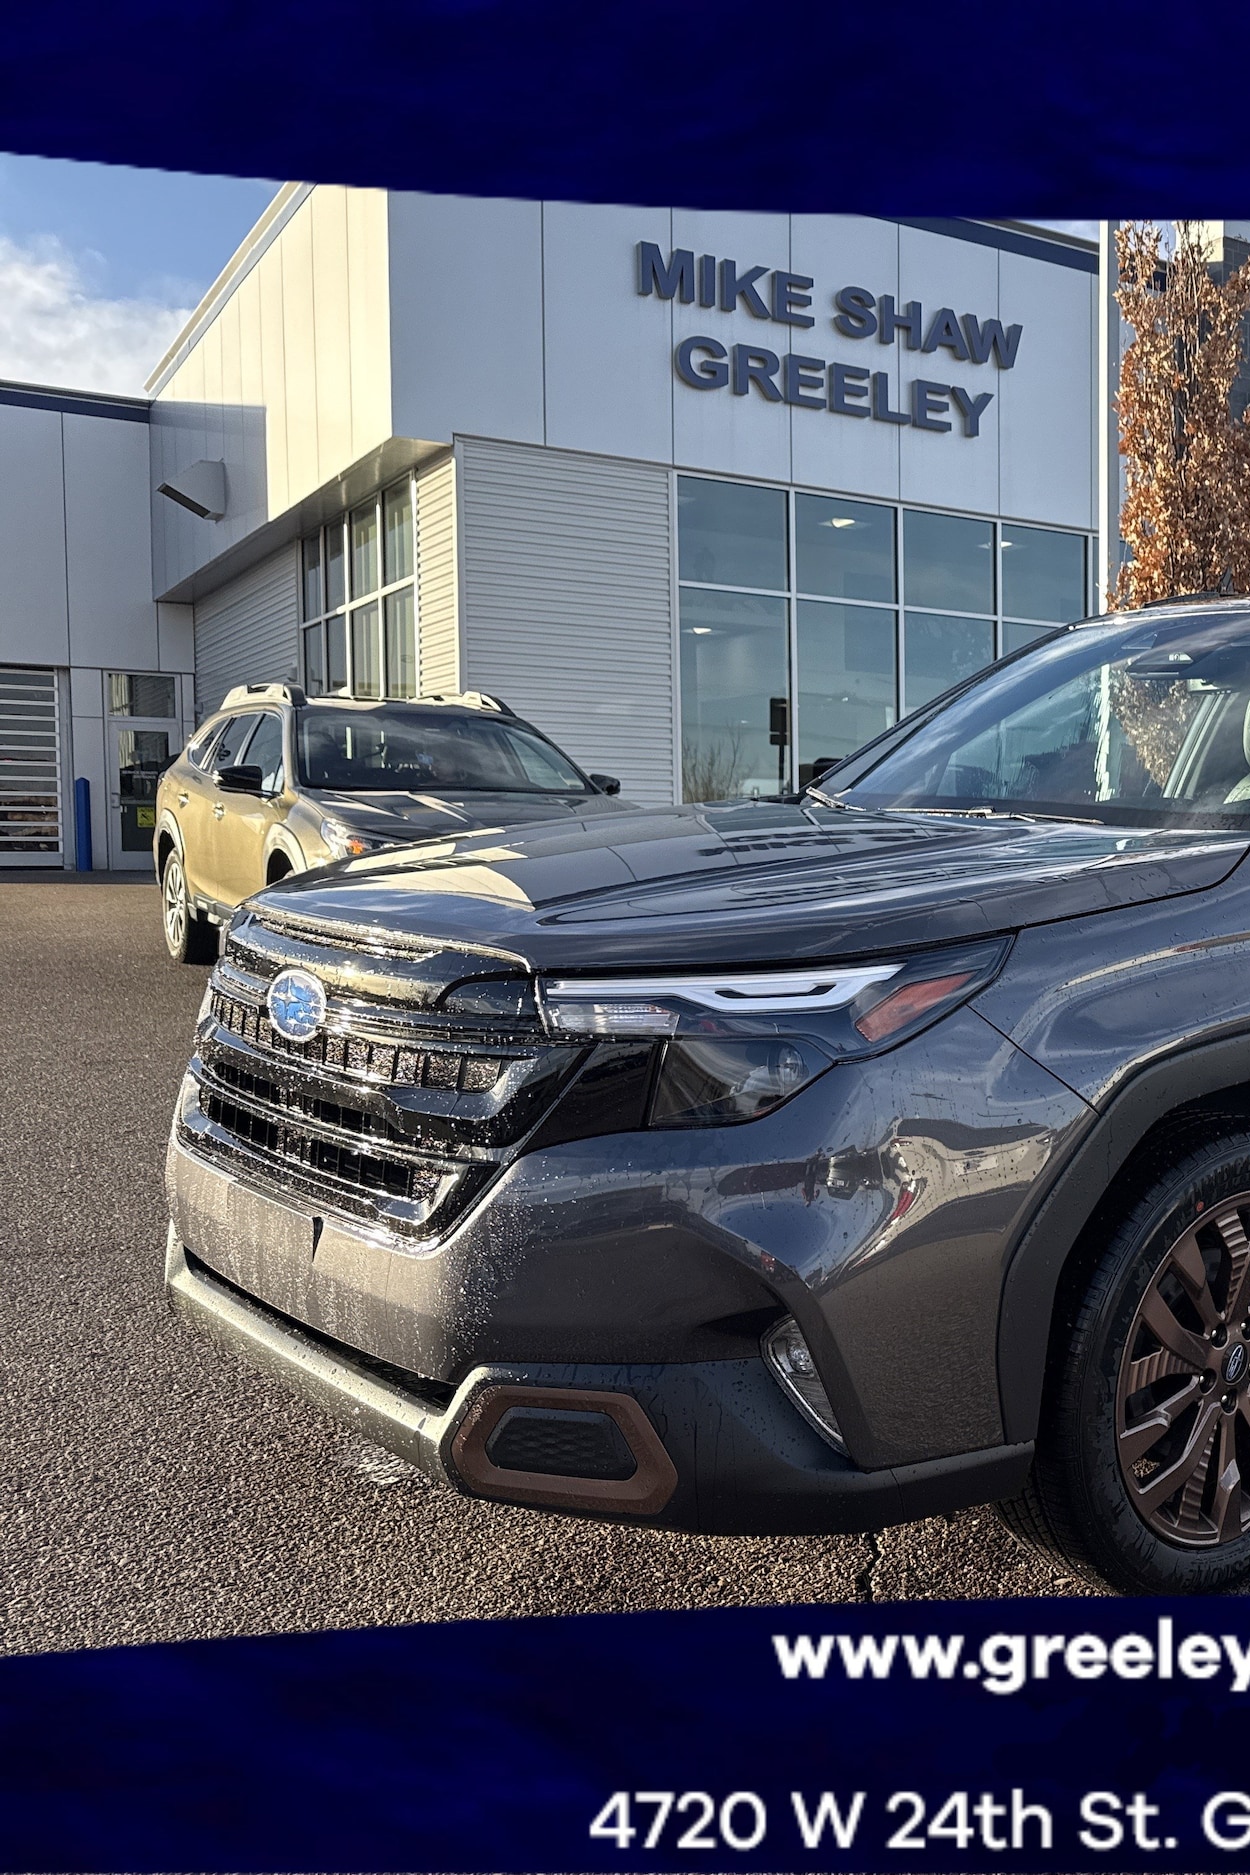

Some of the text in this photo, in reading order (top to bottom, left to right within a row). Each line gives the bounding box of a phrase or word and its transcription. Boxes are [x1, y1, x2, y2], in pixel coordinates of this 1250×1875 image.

[636, 240, 1023, 370] MIKE SHAW
[675, 335, 994, 438] GREELEY
